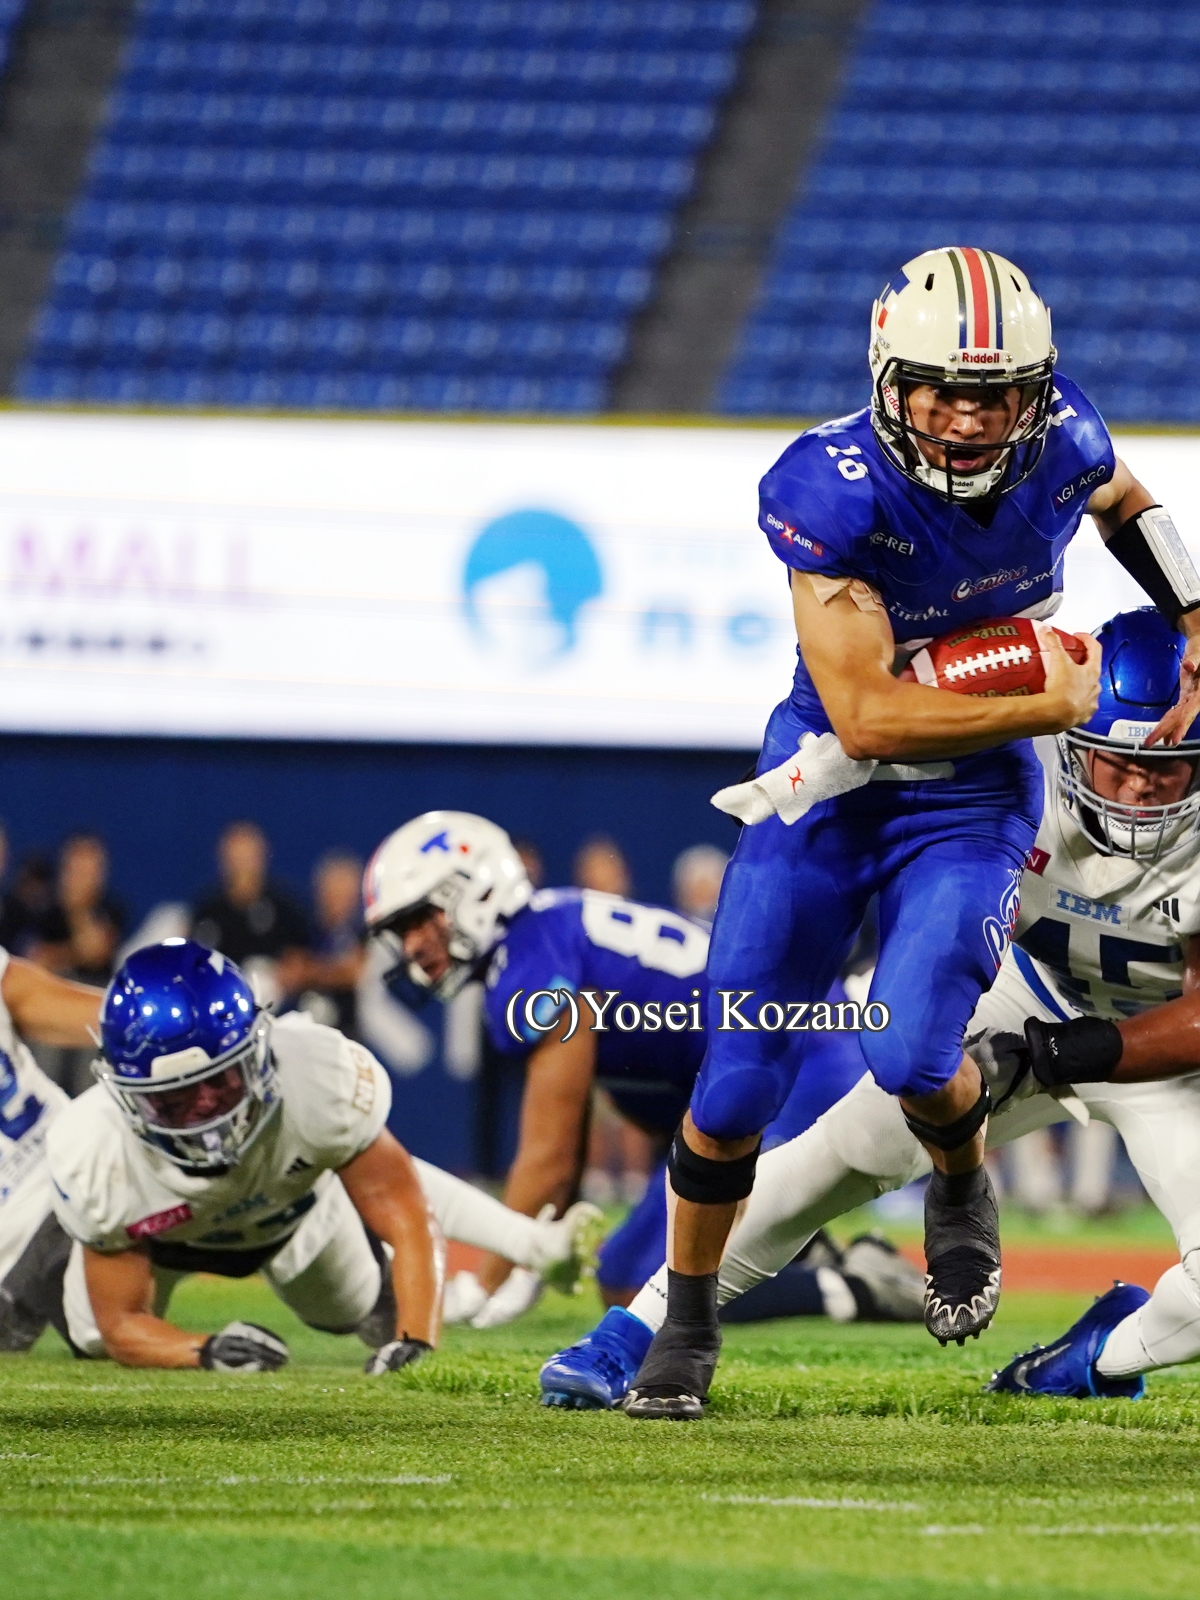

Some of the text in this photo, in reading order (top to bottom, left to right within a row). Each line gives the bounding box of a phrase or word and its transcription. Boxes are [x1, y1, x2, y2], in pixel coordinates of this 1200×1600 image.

[961, 352, 1000, 364] Riddell
[952, 566, 1028, 603] Creators
[1056, 889, 1122, 925] IBM
